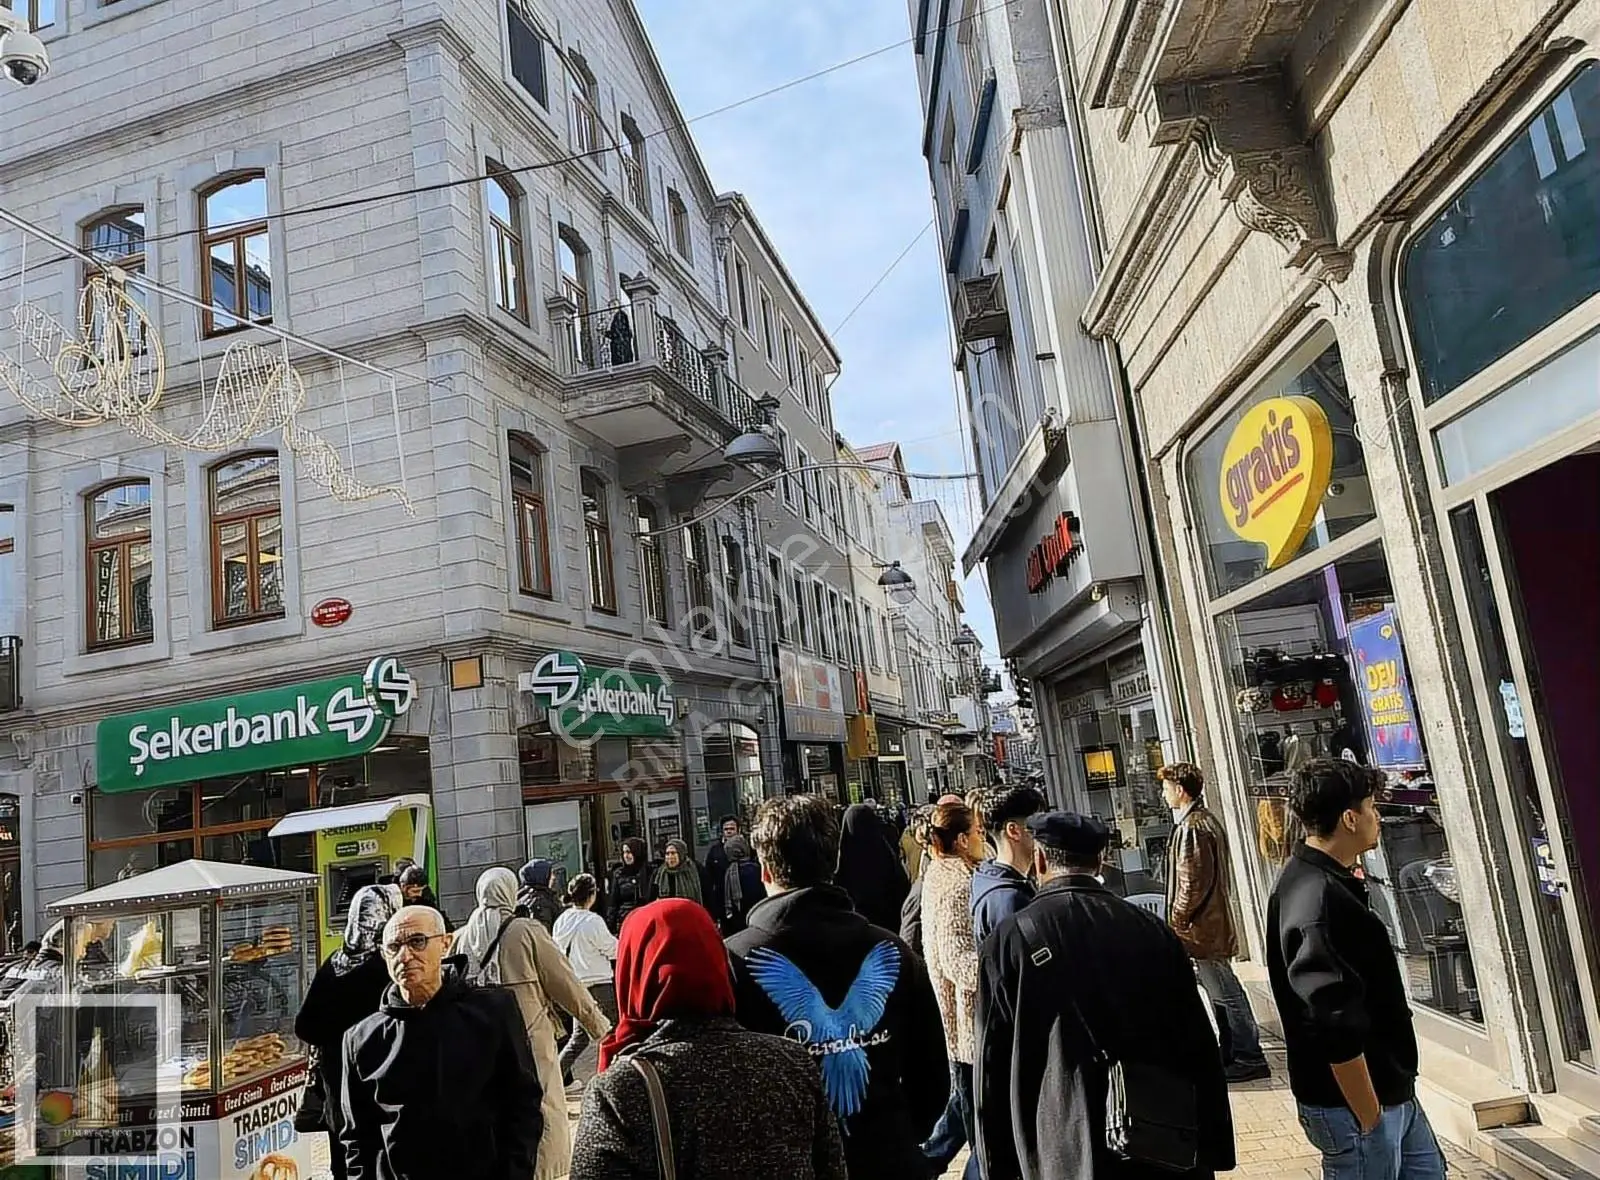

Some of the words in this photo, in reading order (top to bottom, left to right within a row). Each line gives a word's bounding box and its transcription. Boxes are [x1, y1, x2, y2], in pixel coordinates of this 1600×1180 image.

[1226, 409, 1300, 528] gratis
[129, 695, 321, 776] Şekerbank
[784, 1020, 891, 1056] Paradise
[178, 1103, 211, 1118] Simit
[233, 1093, 297, 1137] TRABZON
[89, 1126, 195, 1155] TRABZON
